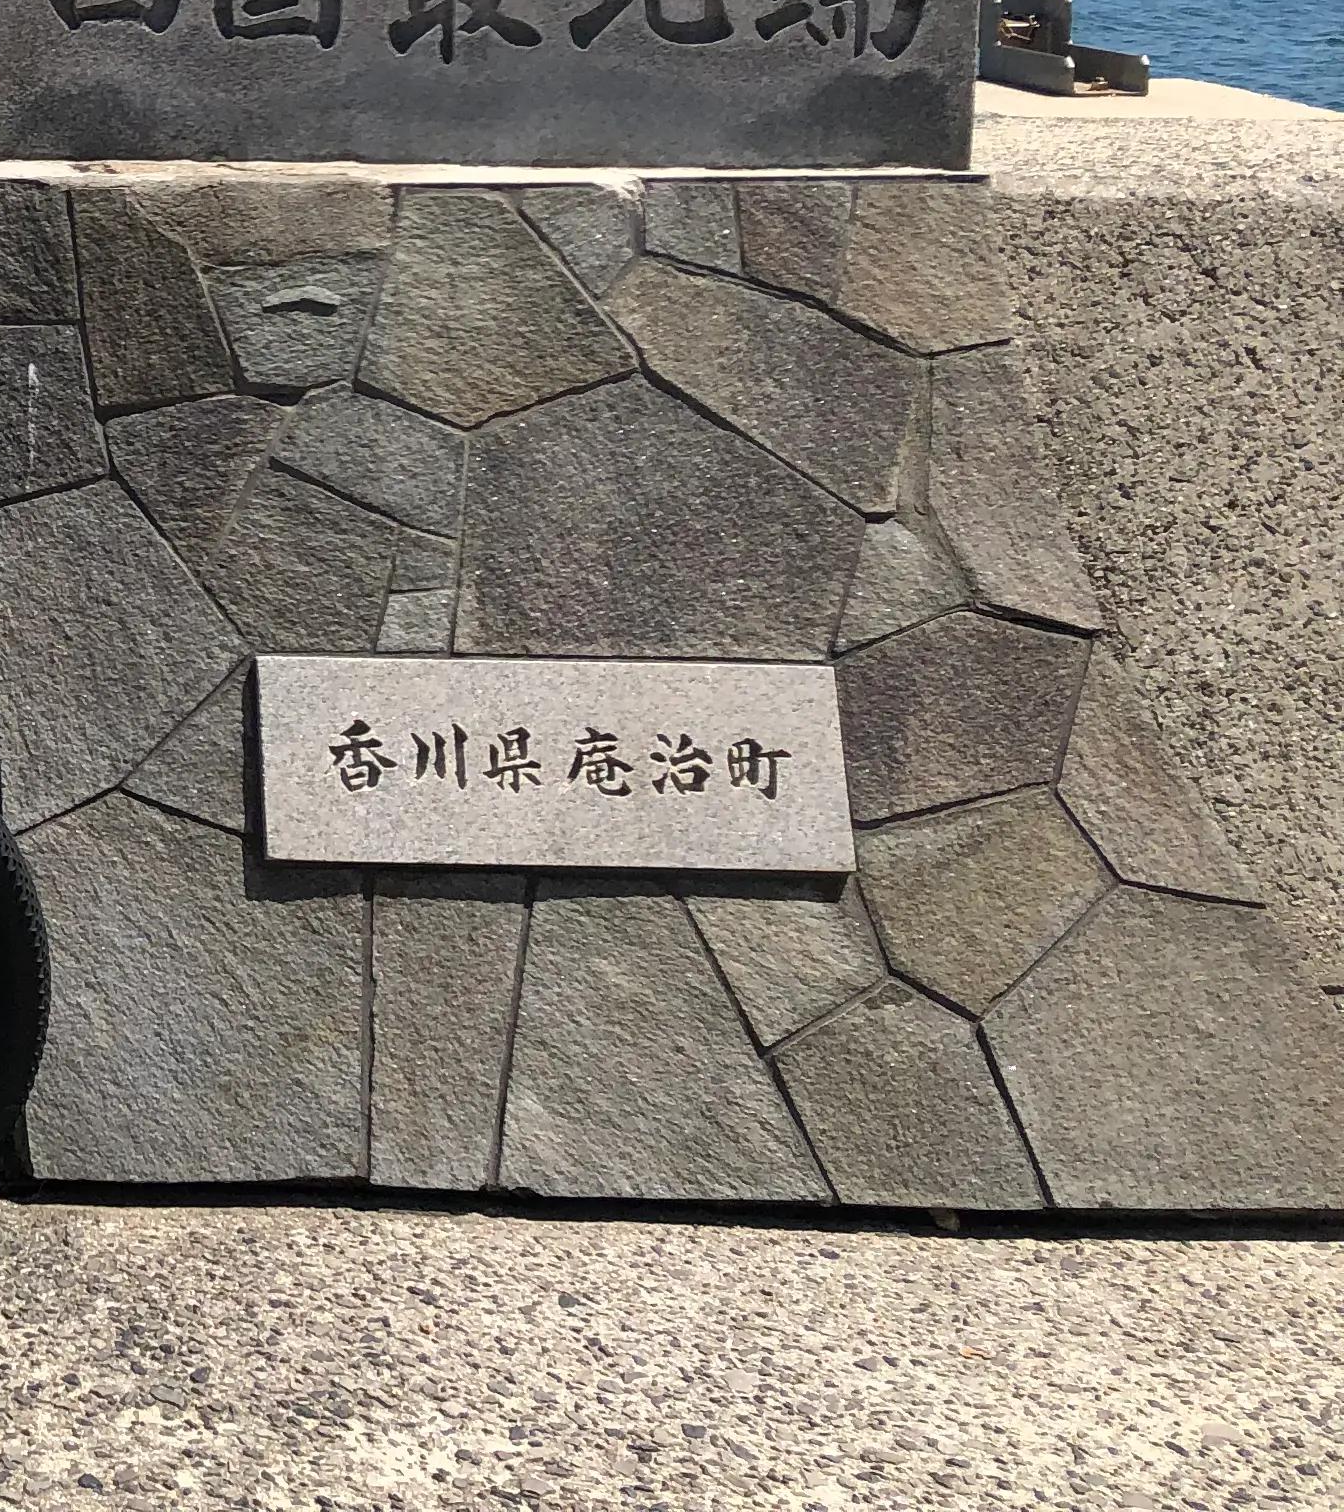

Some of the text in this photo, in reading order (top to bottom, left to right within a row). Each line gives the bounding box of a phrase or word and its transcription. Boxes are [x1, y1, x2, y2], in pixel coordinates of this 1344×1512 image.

[327, 719, 793, 801] 香川県庵治町
